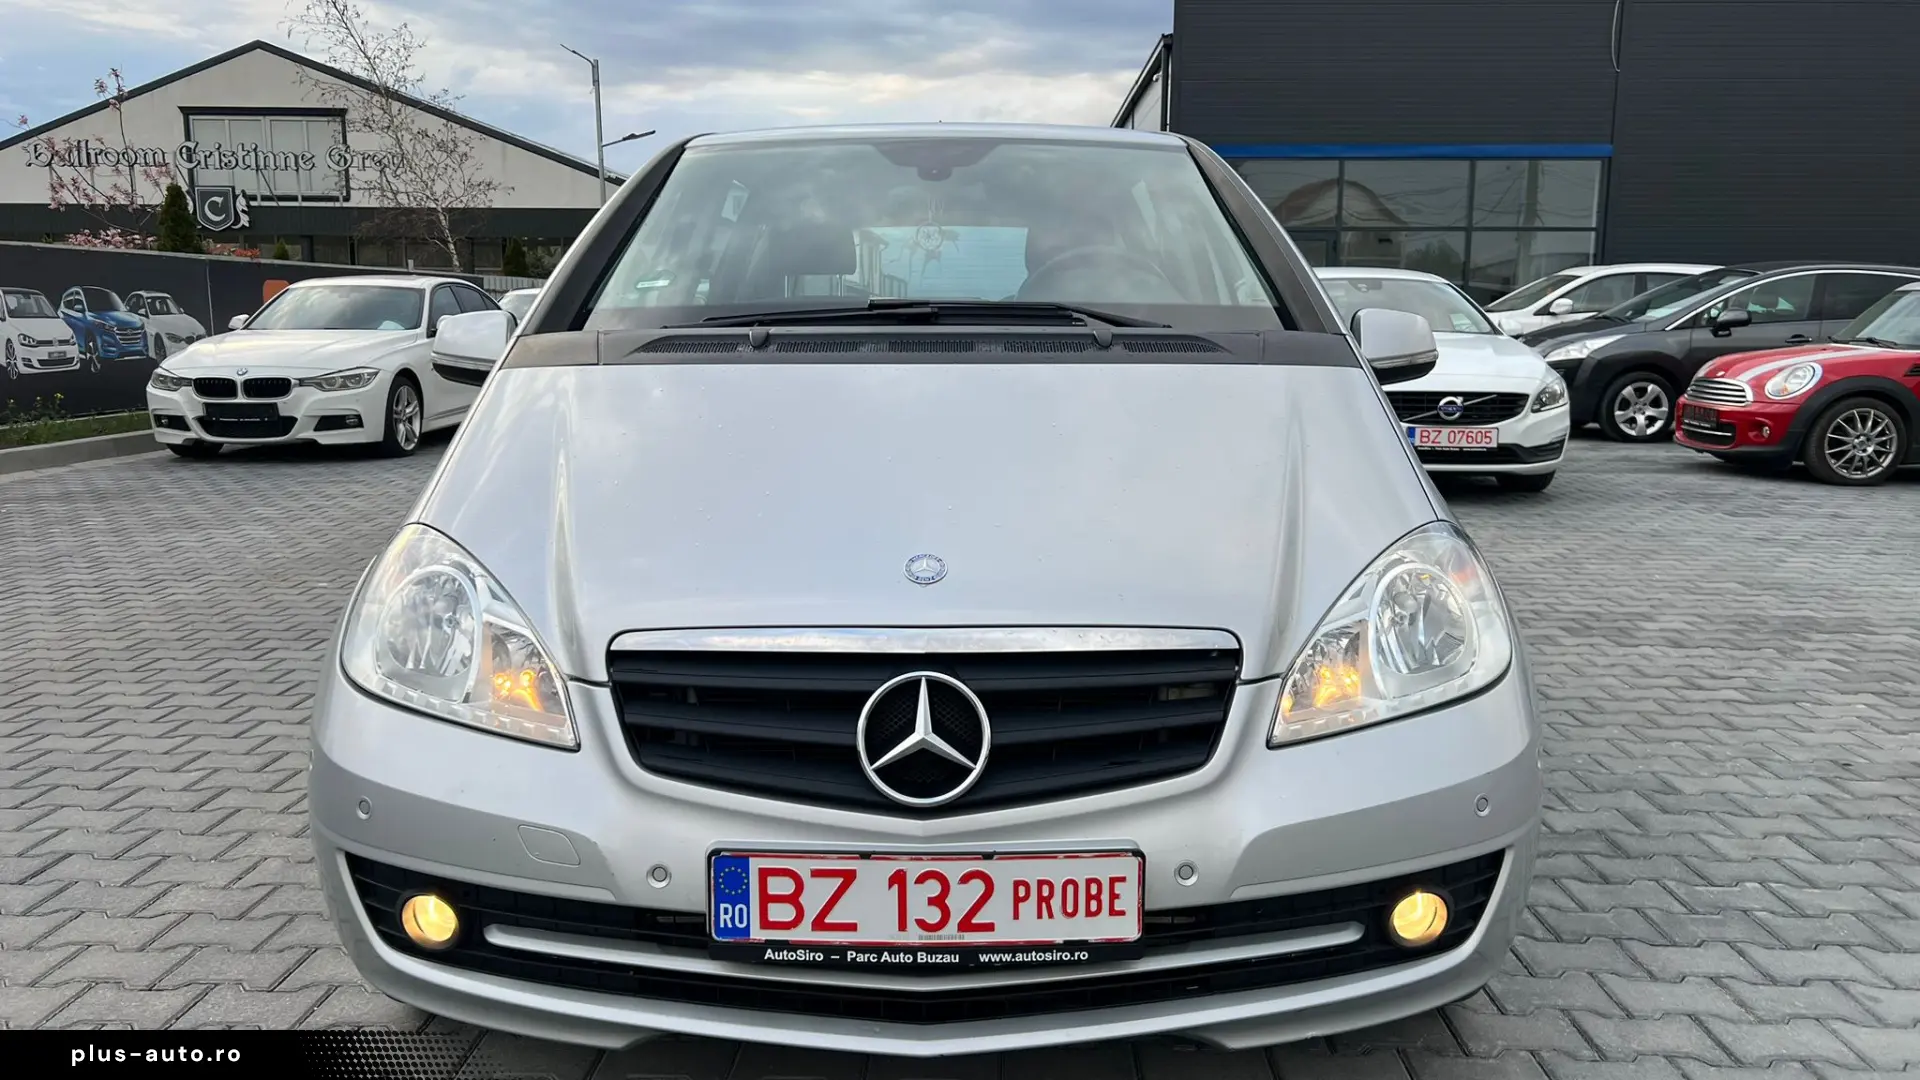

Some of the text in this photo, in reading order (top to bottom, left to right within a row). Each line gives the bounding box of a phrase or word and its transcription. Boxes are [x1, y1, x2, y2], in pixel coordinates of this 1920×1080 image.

[175, 140, 315, 172] Cristinne
[325, 143, 405, 178] Grey
[203, 195, 228, 222] C
[1419, 429, 1442, 445] BZ
[1447, 429, 1493, 445] 07605
[757, 866, 1128, 933] BZ 132 PROBE
[718, 902, 748, 930] RO
[764, 948, 825, 962] AutoSiro
[847, 950, 878, 963] Parc
[881, 951, 913, 964] Auto
[917, 951, 960, 964] Buzau
[978, 949, 1089, 963] www.autosiro.ro
